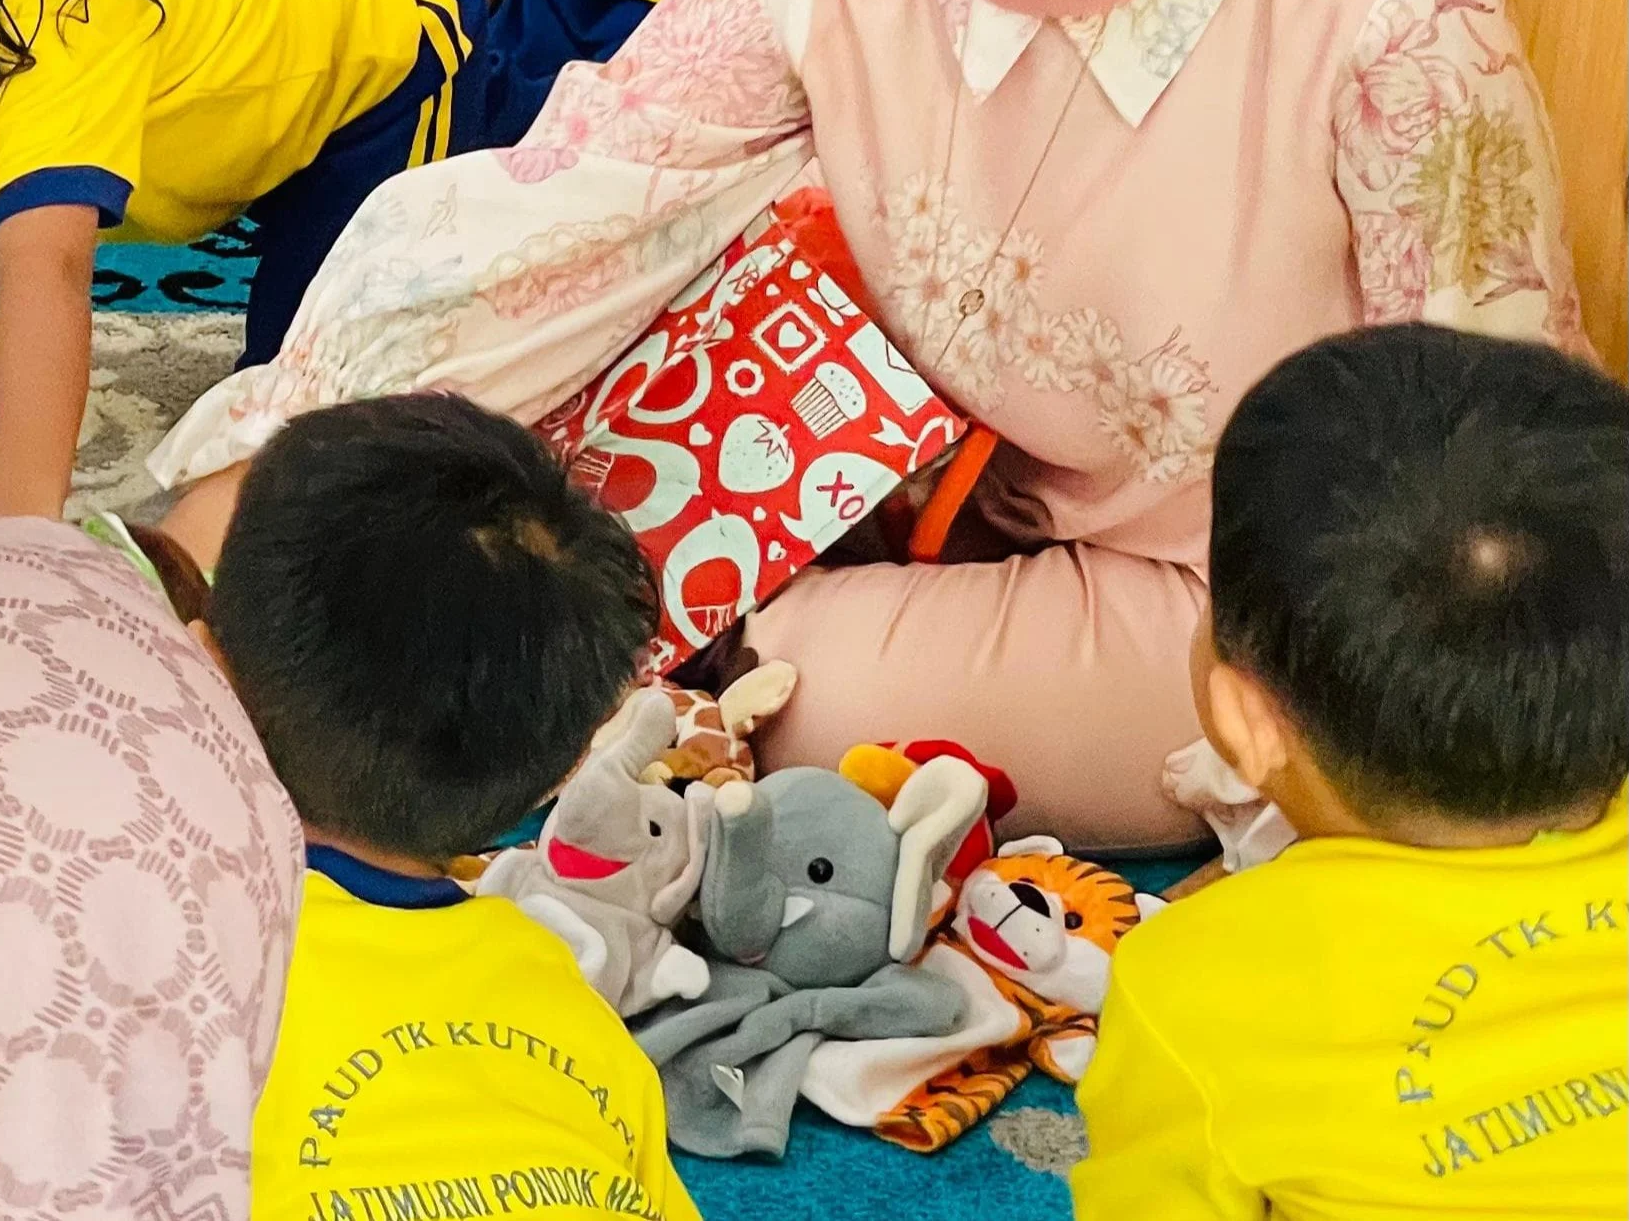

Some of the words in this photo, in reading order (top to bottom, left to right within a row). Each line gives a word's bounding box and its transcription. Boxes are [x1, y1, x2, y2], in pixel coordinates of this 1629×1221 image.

[1395, 963, 1478, 1103] PAUD
[1475, 910, 1562, 959] TK
[1584, 899, 1629, 931] K
[298, 1048, 384, 1169] PAUD
[381, 1021, 441, 1056] TK
[444, 1021, 636, 1162] KUTILAN
[307, 1176, 494, 1221] JATIMURNI
[490, 1167, 600, 1215] PONDOK
